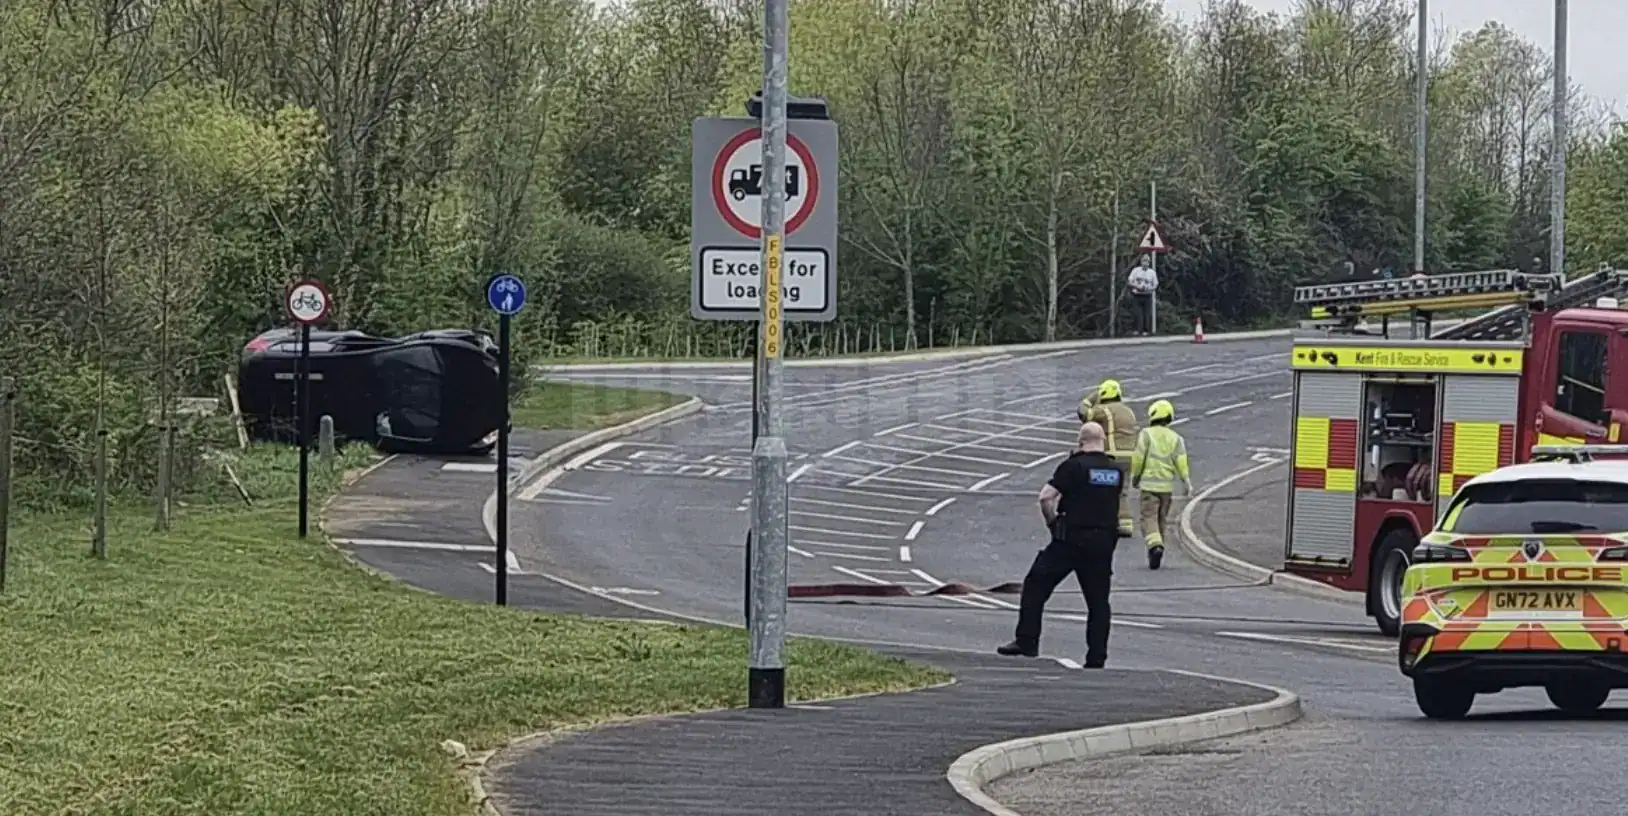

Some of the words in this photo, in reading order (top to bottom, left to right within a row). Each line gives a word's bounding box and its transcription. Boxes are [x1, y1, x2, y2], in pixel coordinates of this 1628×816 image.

[712, 258, 759, 277] Exce
[789, 260, 817, 277] for
[1355, 352, 1374, 365] Kent
[1452, 567, 1622, 582] POLICE
[1496, 592, 1539, 609] GN72
[1544, 592, 1576, 609] AVX
